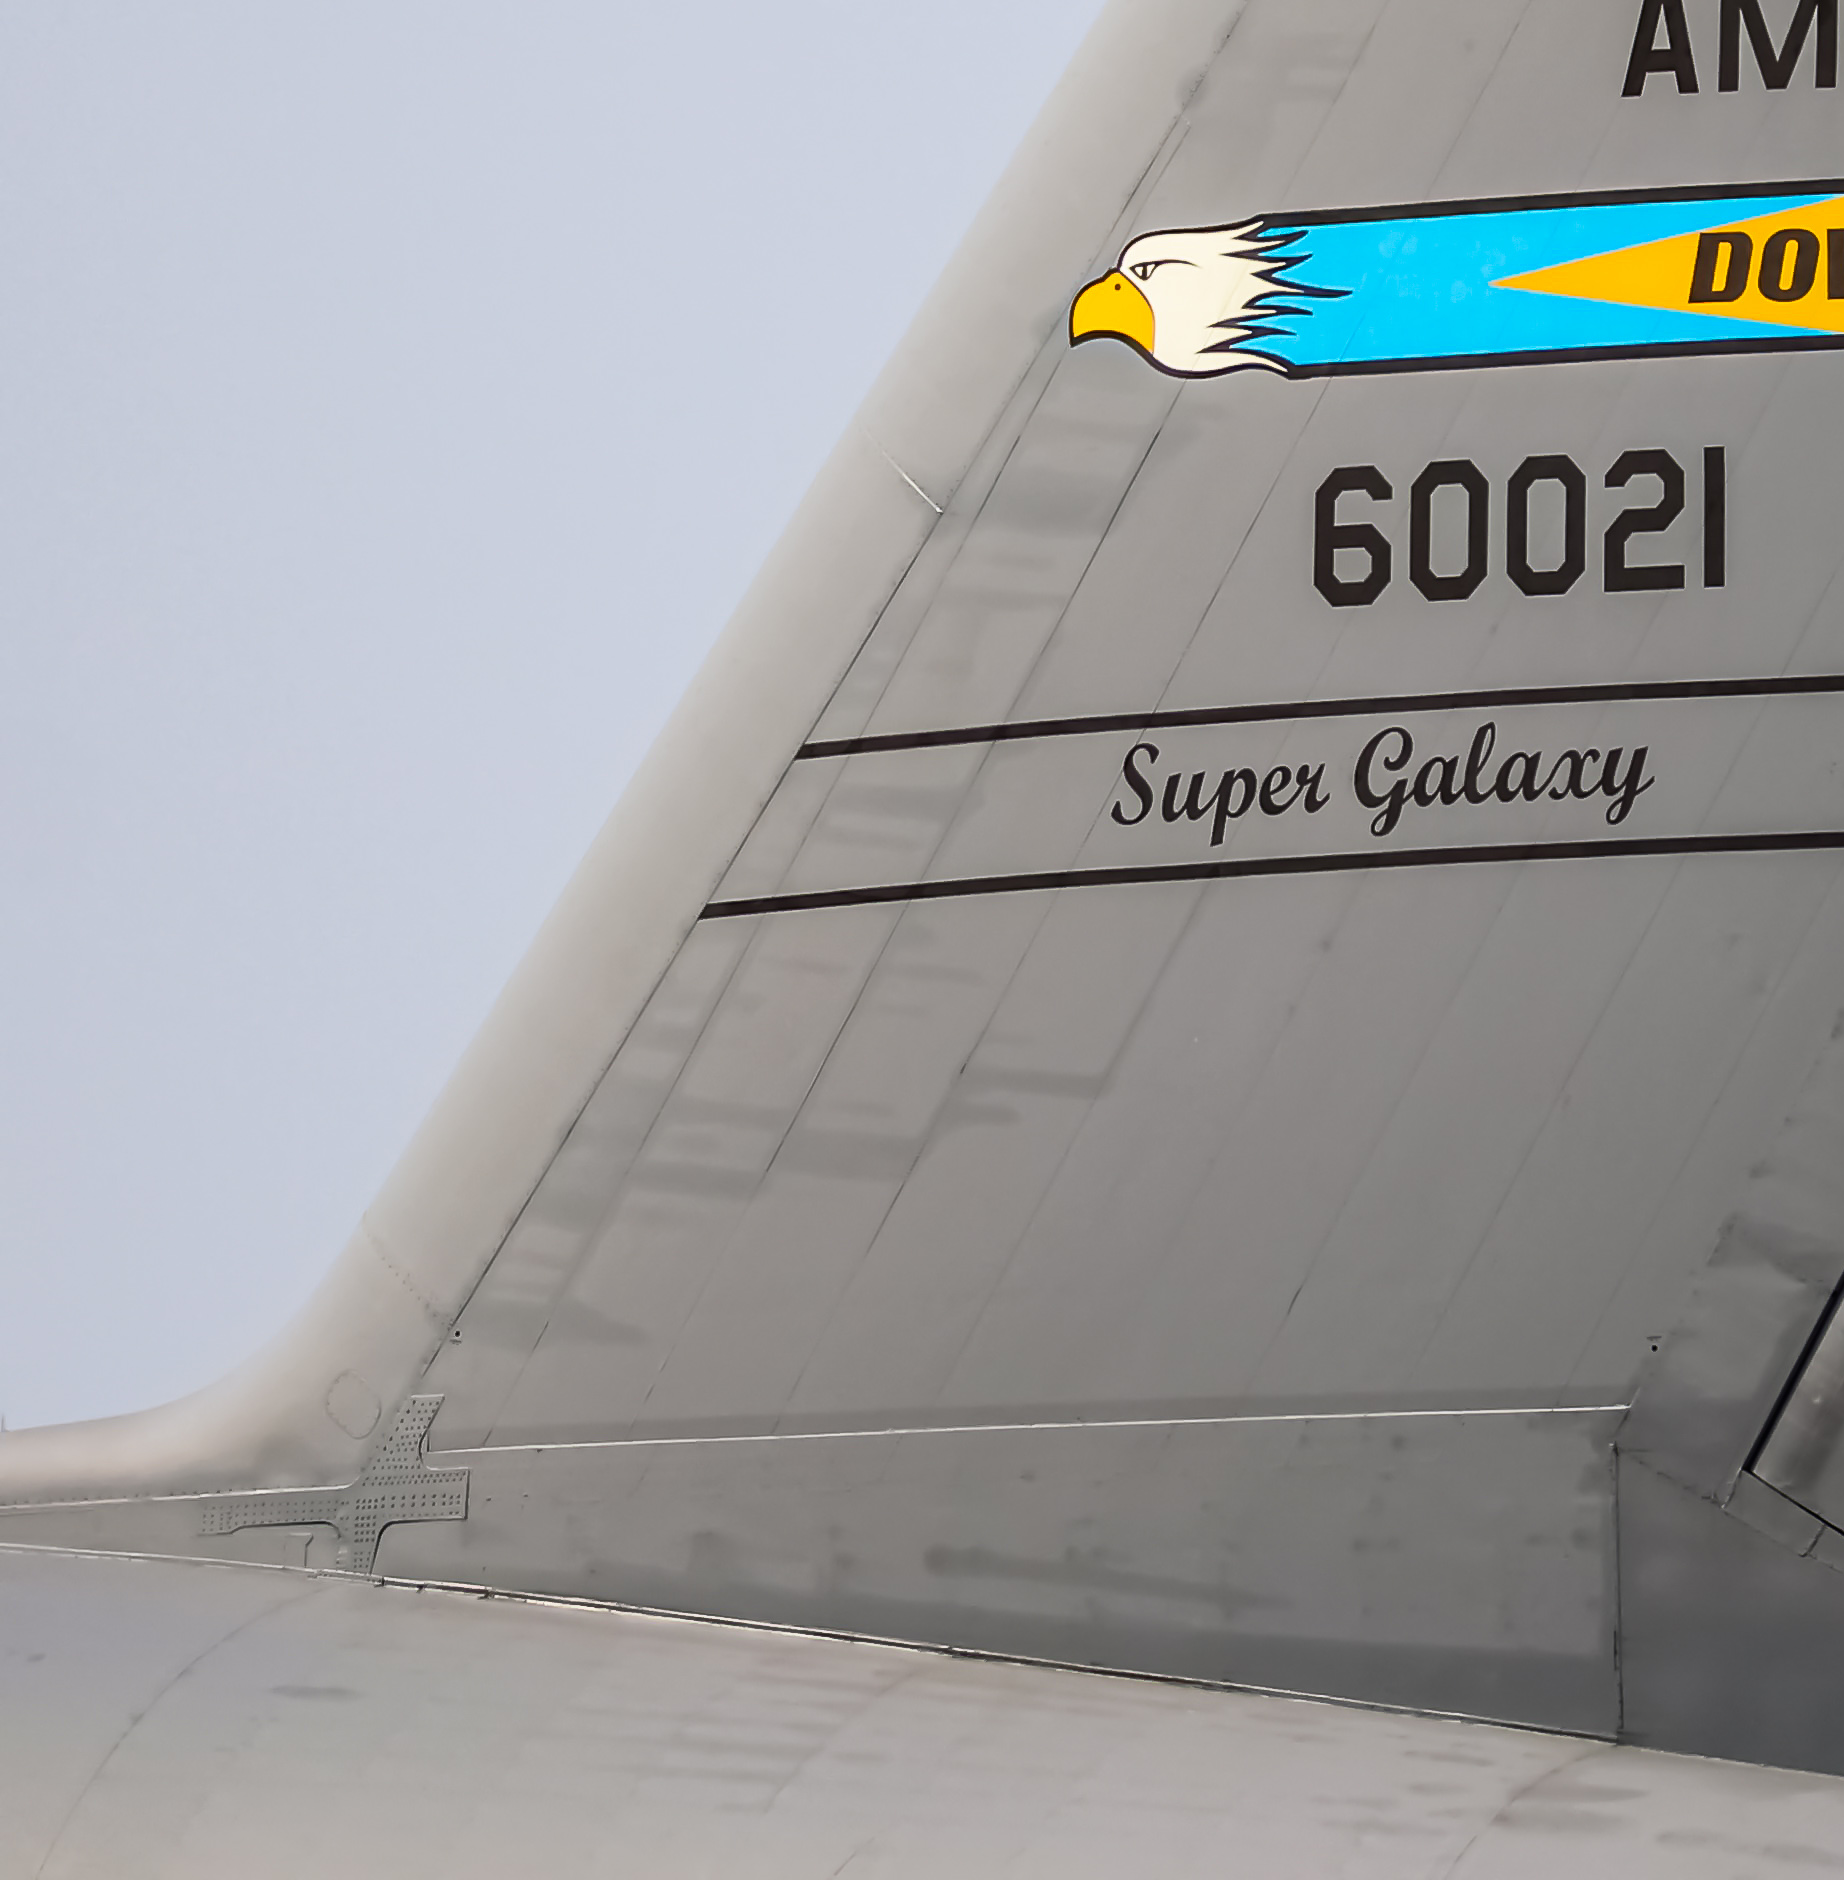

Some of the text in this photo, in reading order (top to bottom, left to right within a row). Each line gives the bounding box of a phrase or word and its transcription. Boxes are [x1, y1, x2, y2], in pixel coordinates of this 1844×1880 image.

[1313, 446, 1726, 608] 60021
[1110, 721, 1656, 847] Super Galaxy
